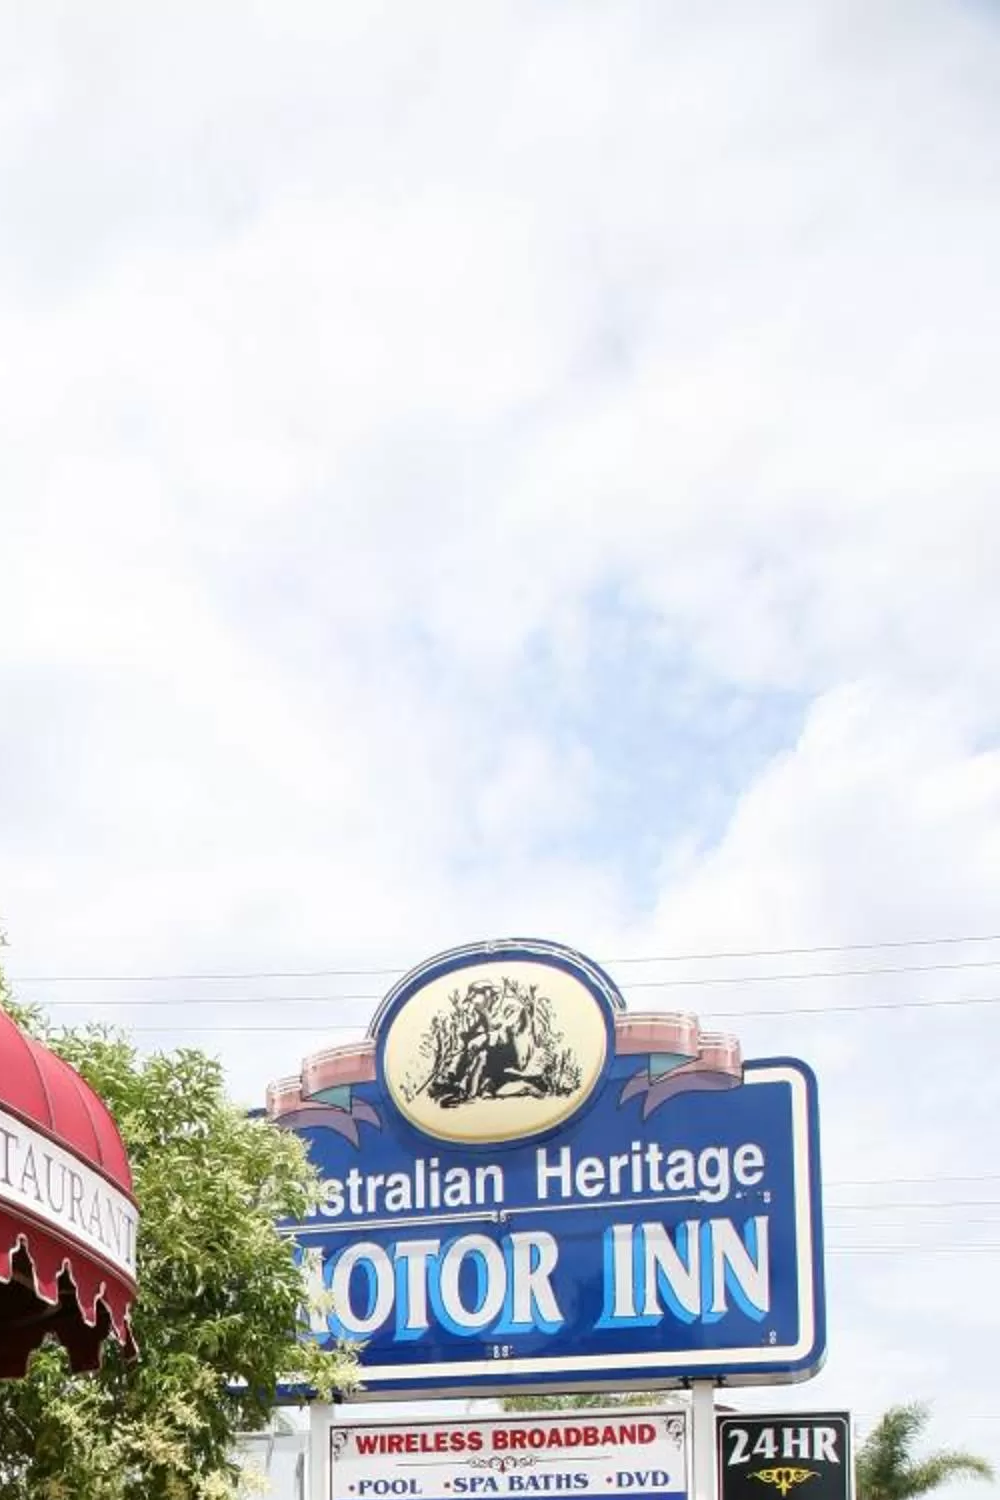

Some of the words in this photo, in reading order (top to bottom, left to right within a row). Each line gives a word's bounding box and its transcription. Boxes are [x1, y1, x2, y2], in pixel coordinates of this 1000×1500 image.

[301, 1157, 505, 1217] stralian
[536, 1140, 765, 1203] Heritage
[608, 1215, 770, 1318] INN
[355, 1431, 483, 1454] WIRELESS
[492, 1424, 657, 1450] BROADBAND
[358, 1479, 422, 1495] POOL
[453, 1476, 499, 1493] SPA
[508, 1473, 589, 1491] BATHS
[616, 1471, 670, 1488] DVD
